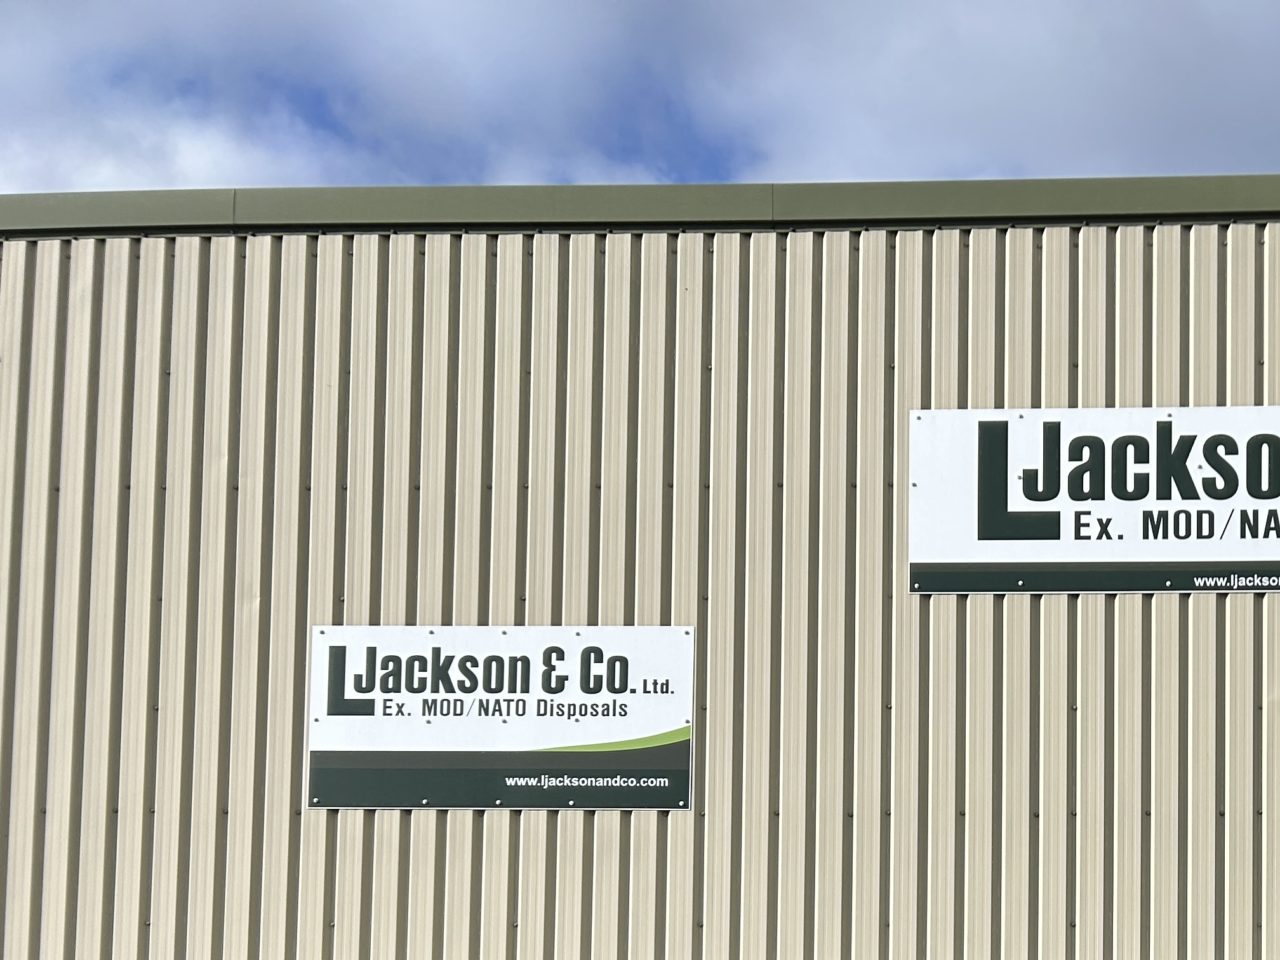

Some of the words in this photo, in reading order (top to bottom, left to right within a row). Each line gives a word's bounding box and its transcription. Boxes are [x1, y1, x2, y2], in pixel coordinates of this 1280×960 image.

[1074, 510, 1125, 541] Ex.
[541, 645, 569, 695] &
[579, 645, 637, 695] Co.
[642, 678, 675, 695] Ltd.
[382, 698, 412, 717] Ex.
[421, 697, 527, 718] MOD/NATO
[536, 697, 629, 720] Disposals
[504, 773, 670, 790] www.ljacksonandco.com
